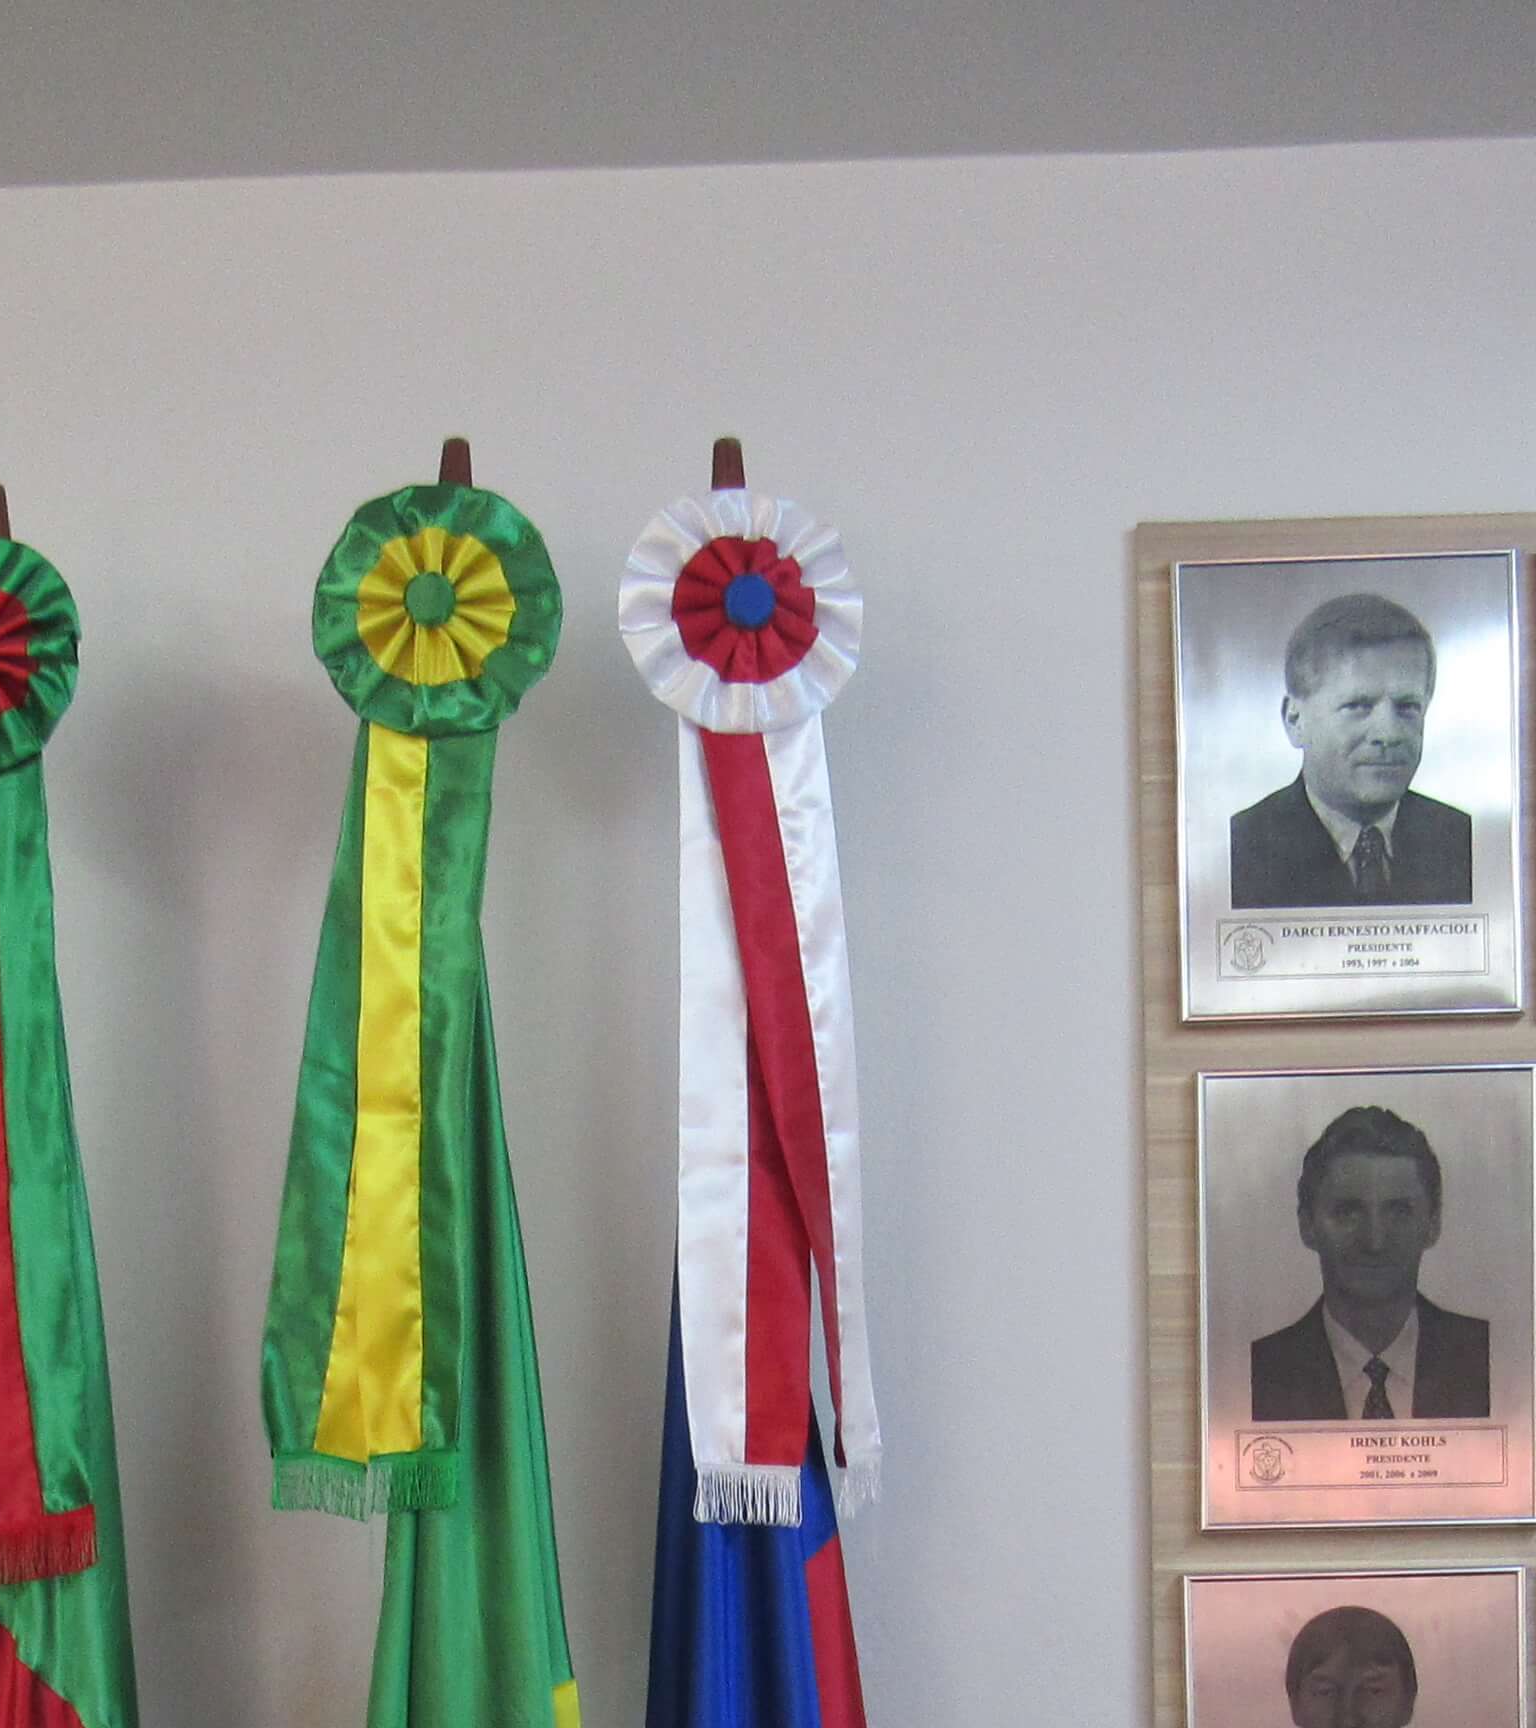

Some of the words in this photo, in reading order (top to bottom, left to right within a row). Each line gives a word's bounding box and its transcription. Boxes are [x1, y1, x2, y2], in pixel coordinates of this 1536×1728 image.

[1282, 926, 1325, 937] DARCI
[1328, 925, 1389, 937] ERNESTO
[1393, 924, 1478, 936] MAFFACIOLI
[1347, 943, 1413, 952] PRESIDENTE
[1350, 1437, 1397, 1449] IRINEU
[1400, 1436, 1447, 1447] KOHLS
[1366, 1454, 1430, 1464] PRESIDENTE
